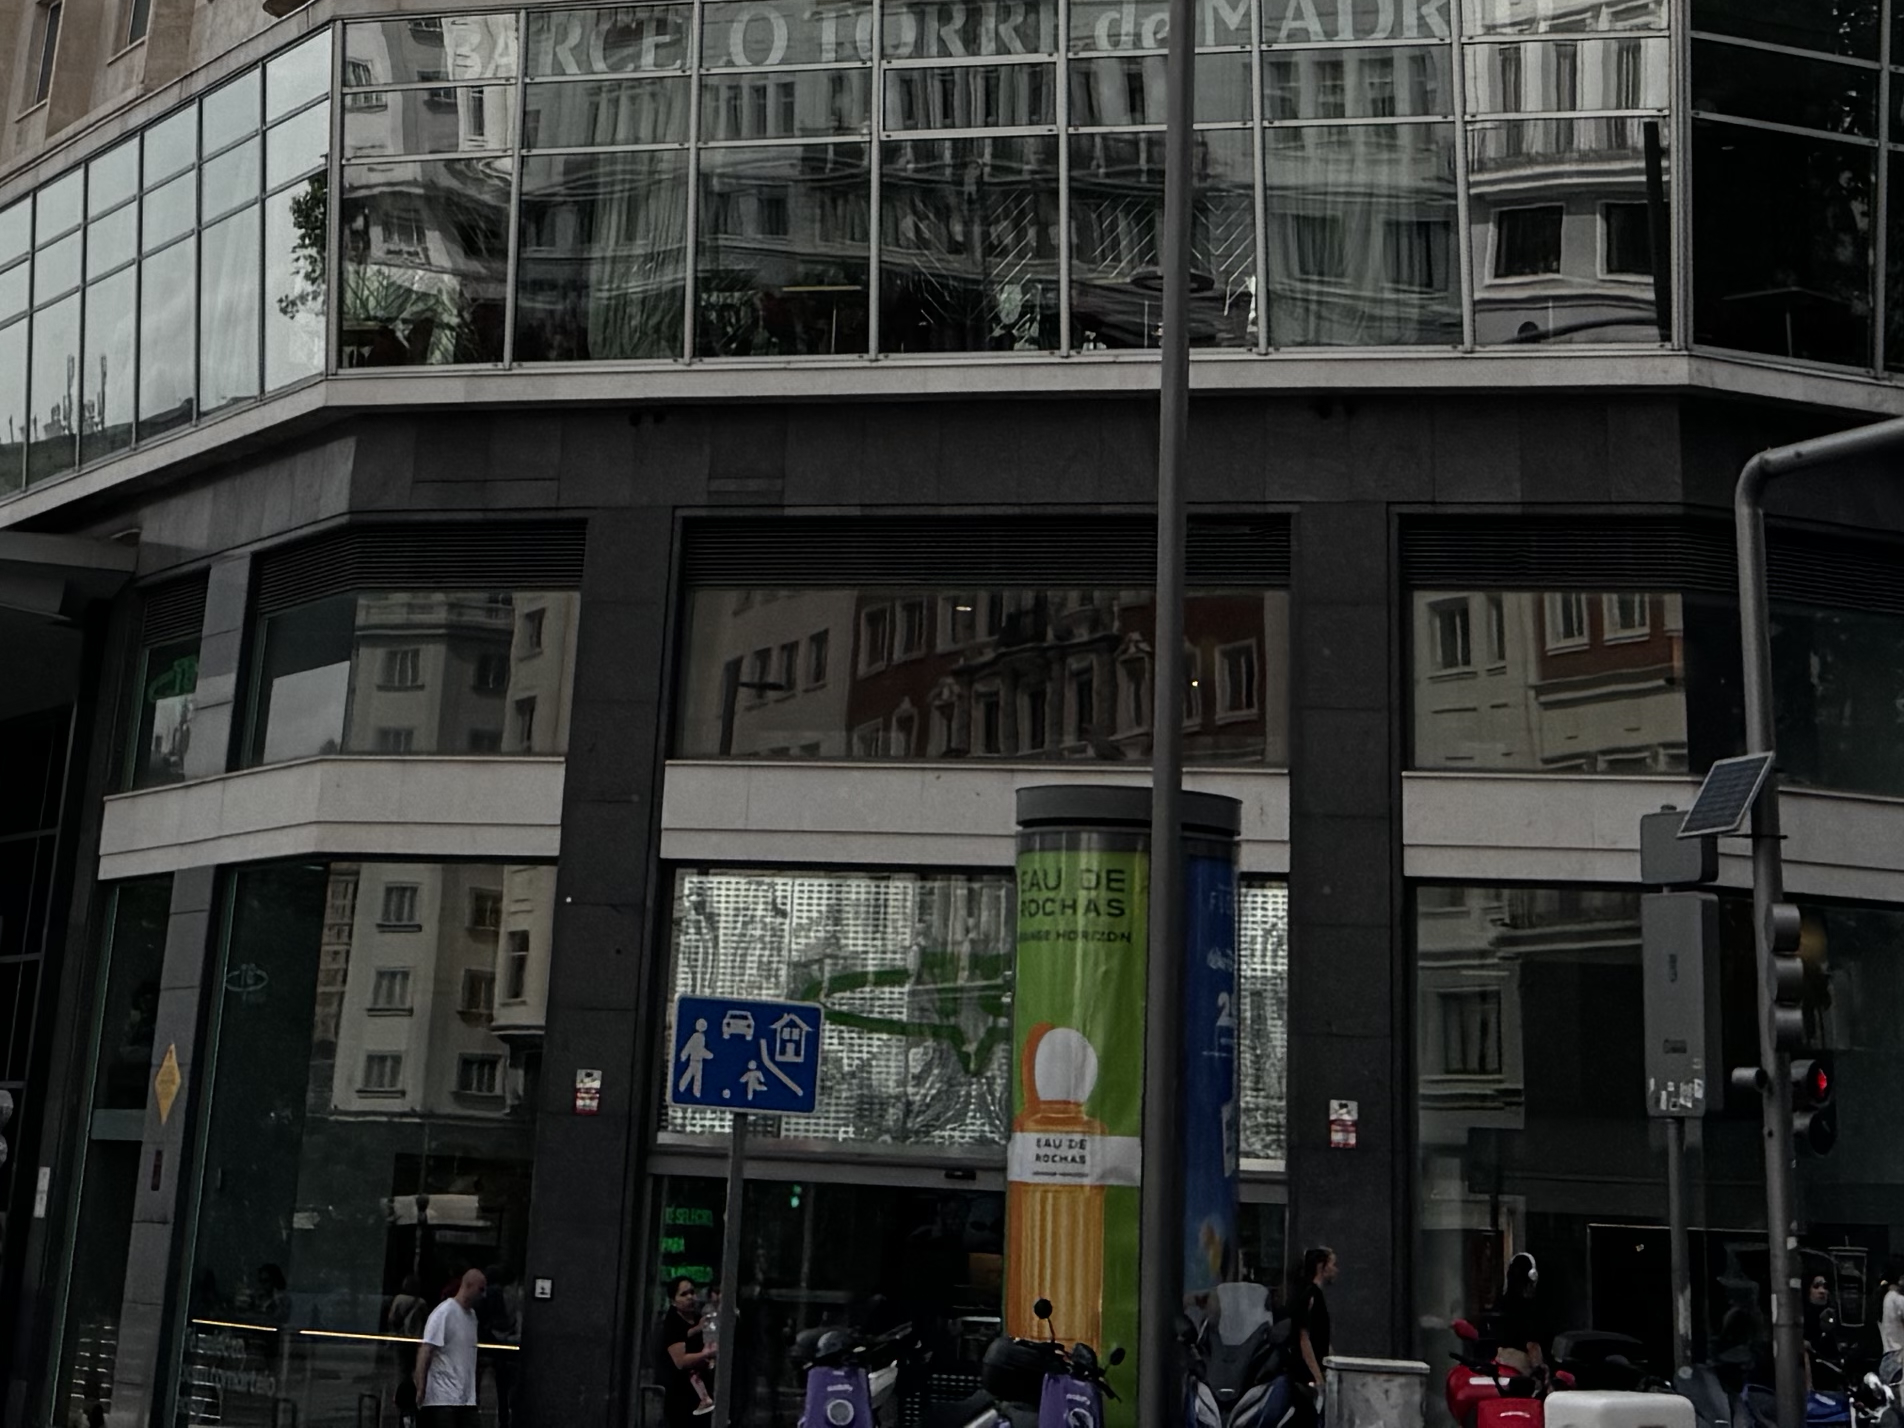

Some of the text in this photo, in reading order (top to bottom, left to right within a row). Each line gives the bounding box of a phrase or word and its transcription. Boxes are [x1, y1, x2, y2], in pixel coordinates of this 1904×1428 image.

[446, 6, 789, 82] BARCEO
[1021, 868, 1125, 893] EAU DE
[1021, 898, 1125, 918] ROCHAS
[1036, 1138, 1087, 1150] EAU DE
[1035, 1153, 1087, 1164] ROCHAS
